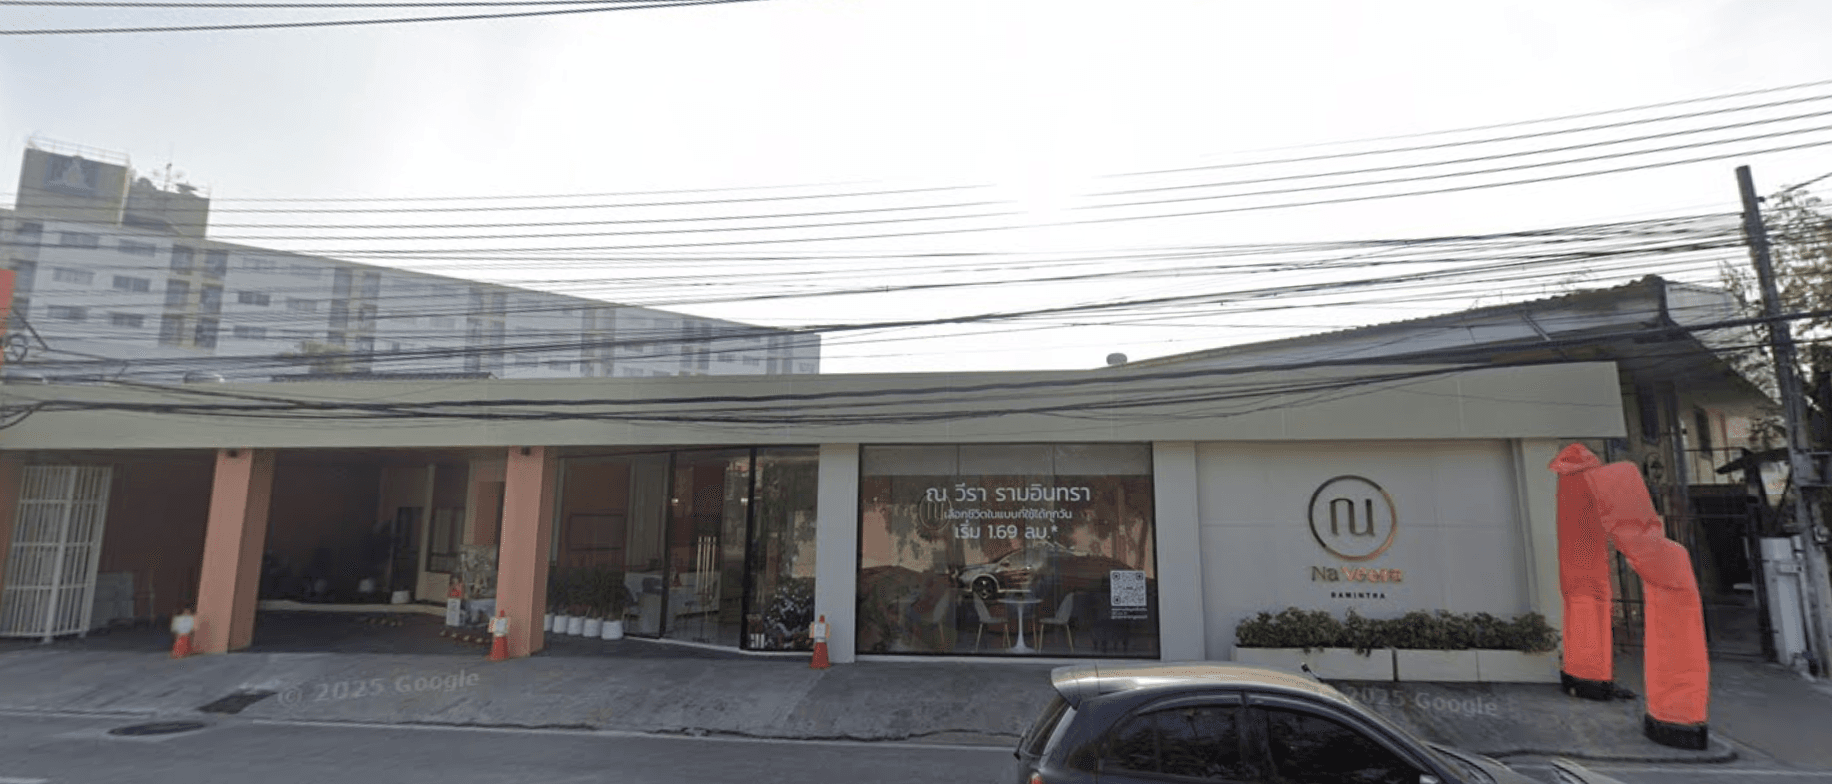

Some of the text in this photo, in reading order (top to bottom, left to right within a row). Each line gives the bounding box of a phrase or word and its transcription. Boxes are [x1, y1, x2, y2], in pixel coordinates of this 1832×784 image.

[926, 483, 1091, 502] ณ วีรา รามอินทรา
[955, 519, 980, 539] เริ่ม
[987, 524, 1018, 539] 1.69
[1331, 591, 1386, 599] RAMINTRA
